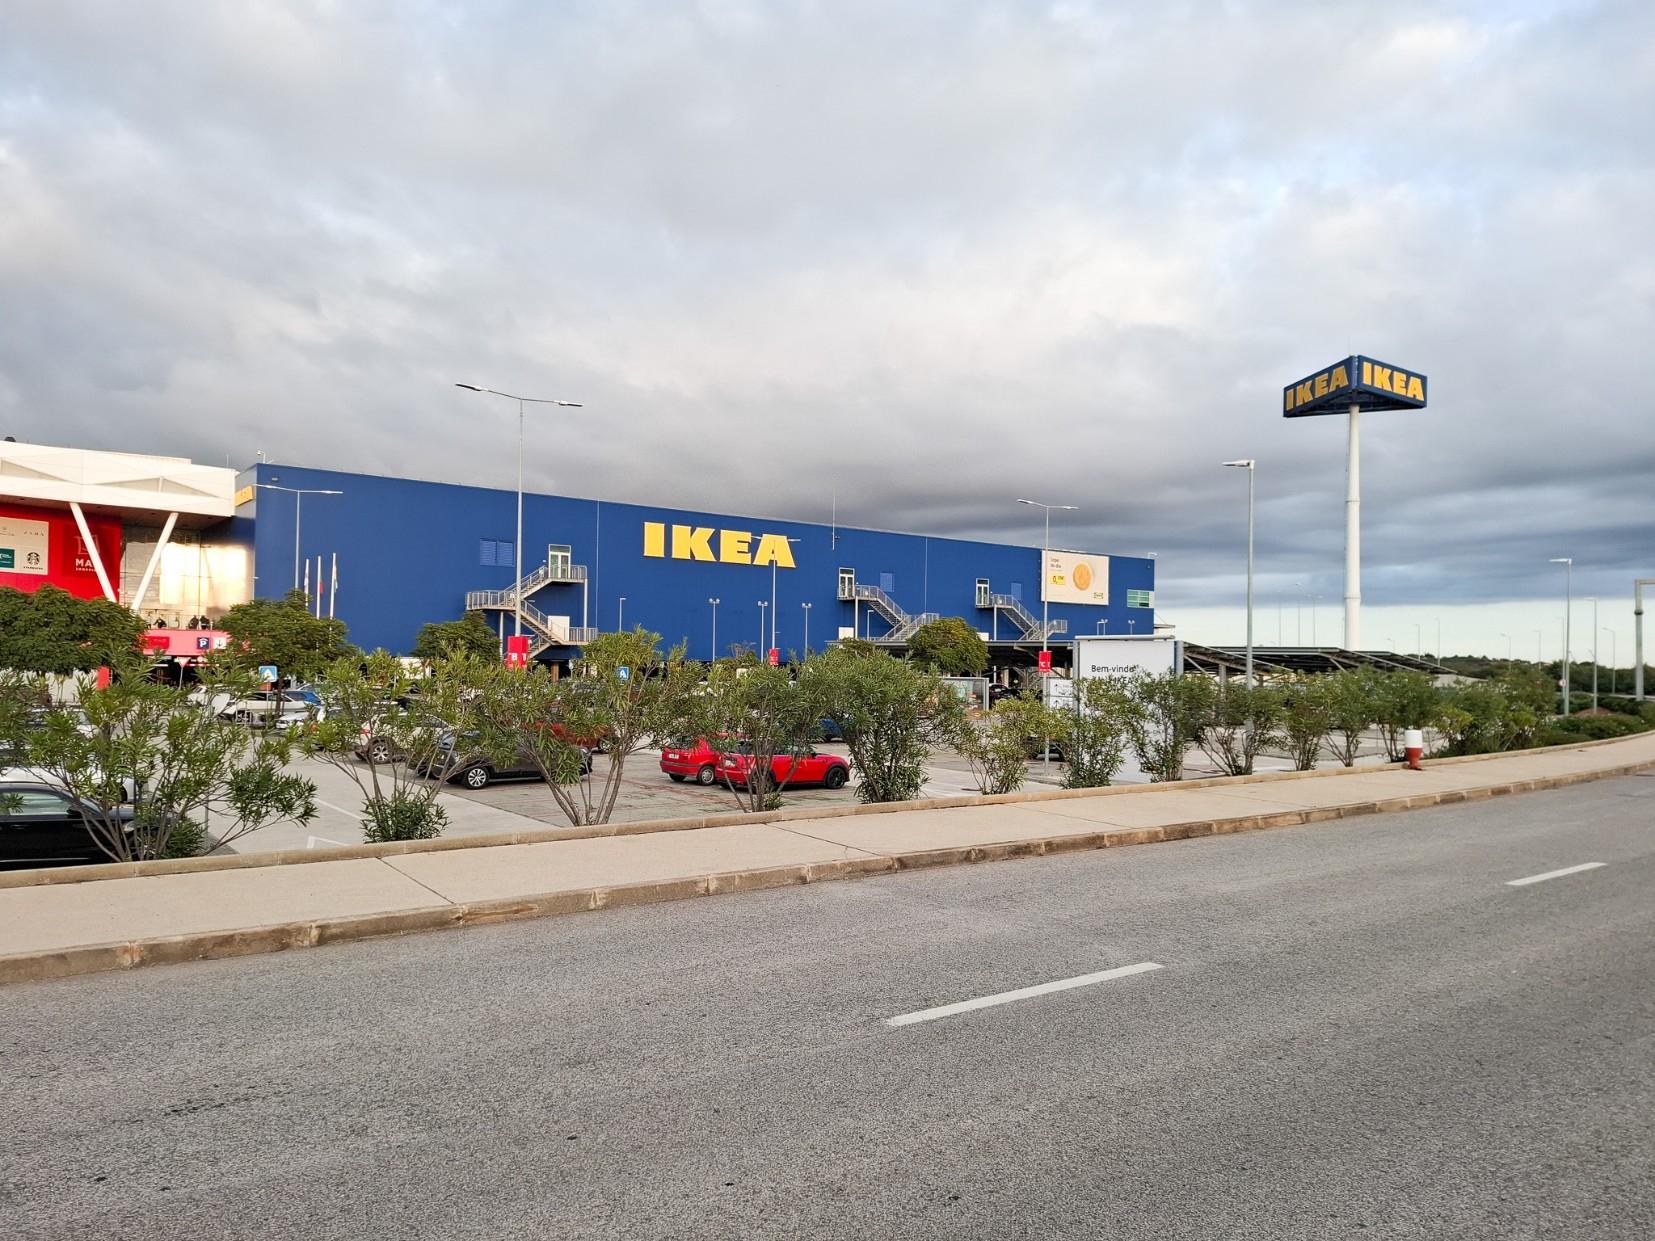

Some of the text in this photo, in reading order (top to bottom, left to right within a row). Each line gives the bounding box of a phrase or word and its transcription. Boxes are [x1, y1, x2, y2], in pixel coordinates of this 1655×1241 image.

[1286, 365, 1349, 411] IKEA
[1363, 361, 1425, 401] IKEA
[75, 558, 93, 568] MA
[643, 521, 796, 568] IKEA
[1091, 664, 1134, 673] Bem-vindo
